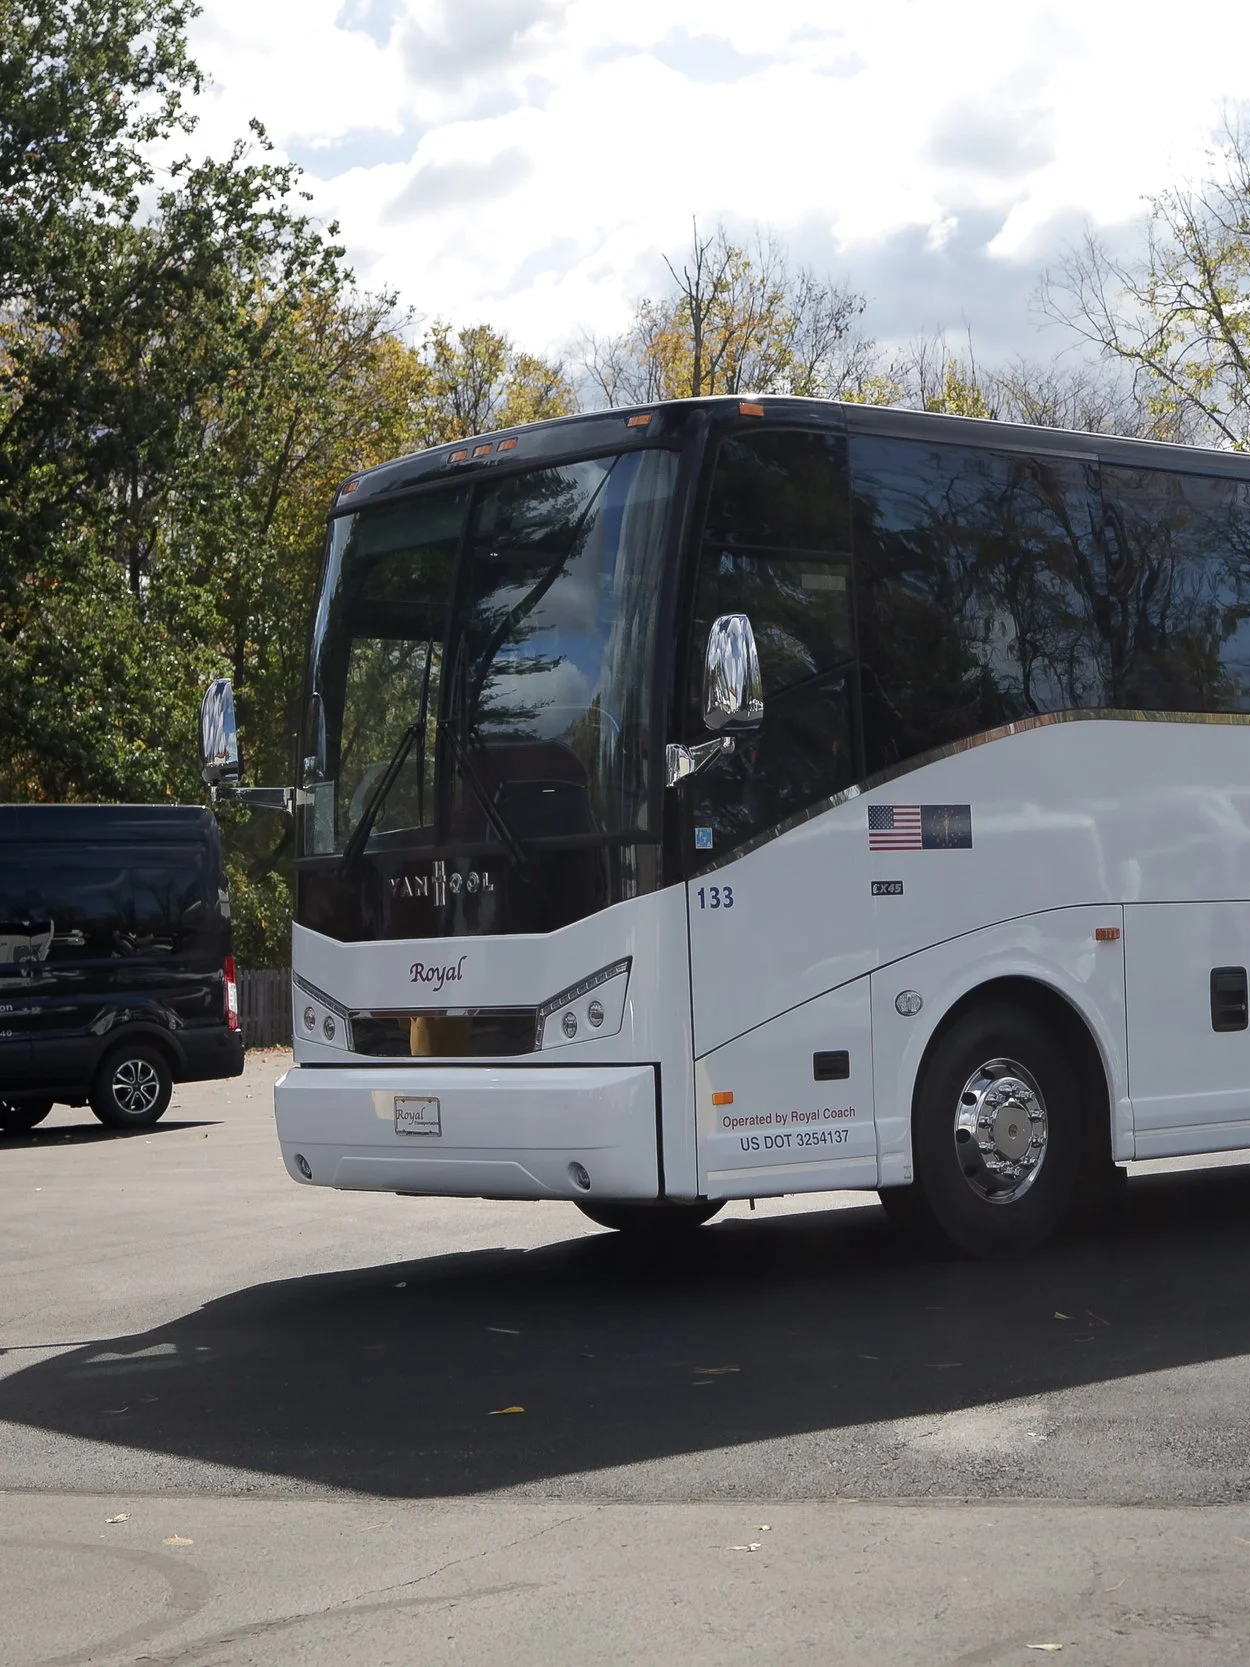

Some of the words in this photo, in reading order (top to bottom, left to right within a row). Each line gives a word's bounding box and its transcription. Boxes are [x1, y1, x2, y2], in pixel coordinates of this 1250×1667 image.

[697, 886, 734, 909] 133
[872, 883, 902, 894] CX45
[410, 955, 468, 992] Royal
[396, 1106, 426, 1126] Royal
[722, 1113, 772, 1130] Operated
[775, 1113, 788, 1126] by
[791, 1109, 820, 1124] Royal
[823, 1106, 856, 1120] Coach
[740, 1136, 760, 1152] US
[764, 1134, 792, 1149] DOT
[796, 1129, 849, 1147] 3254137
